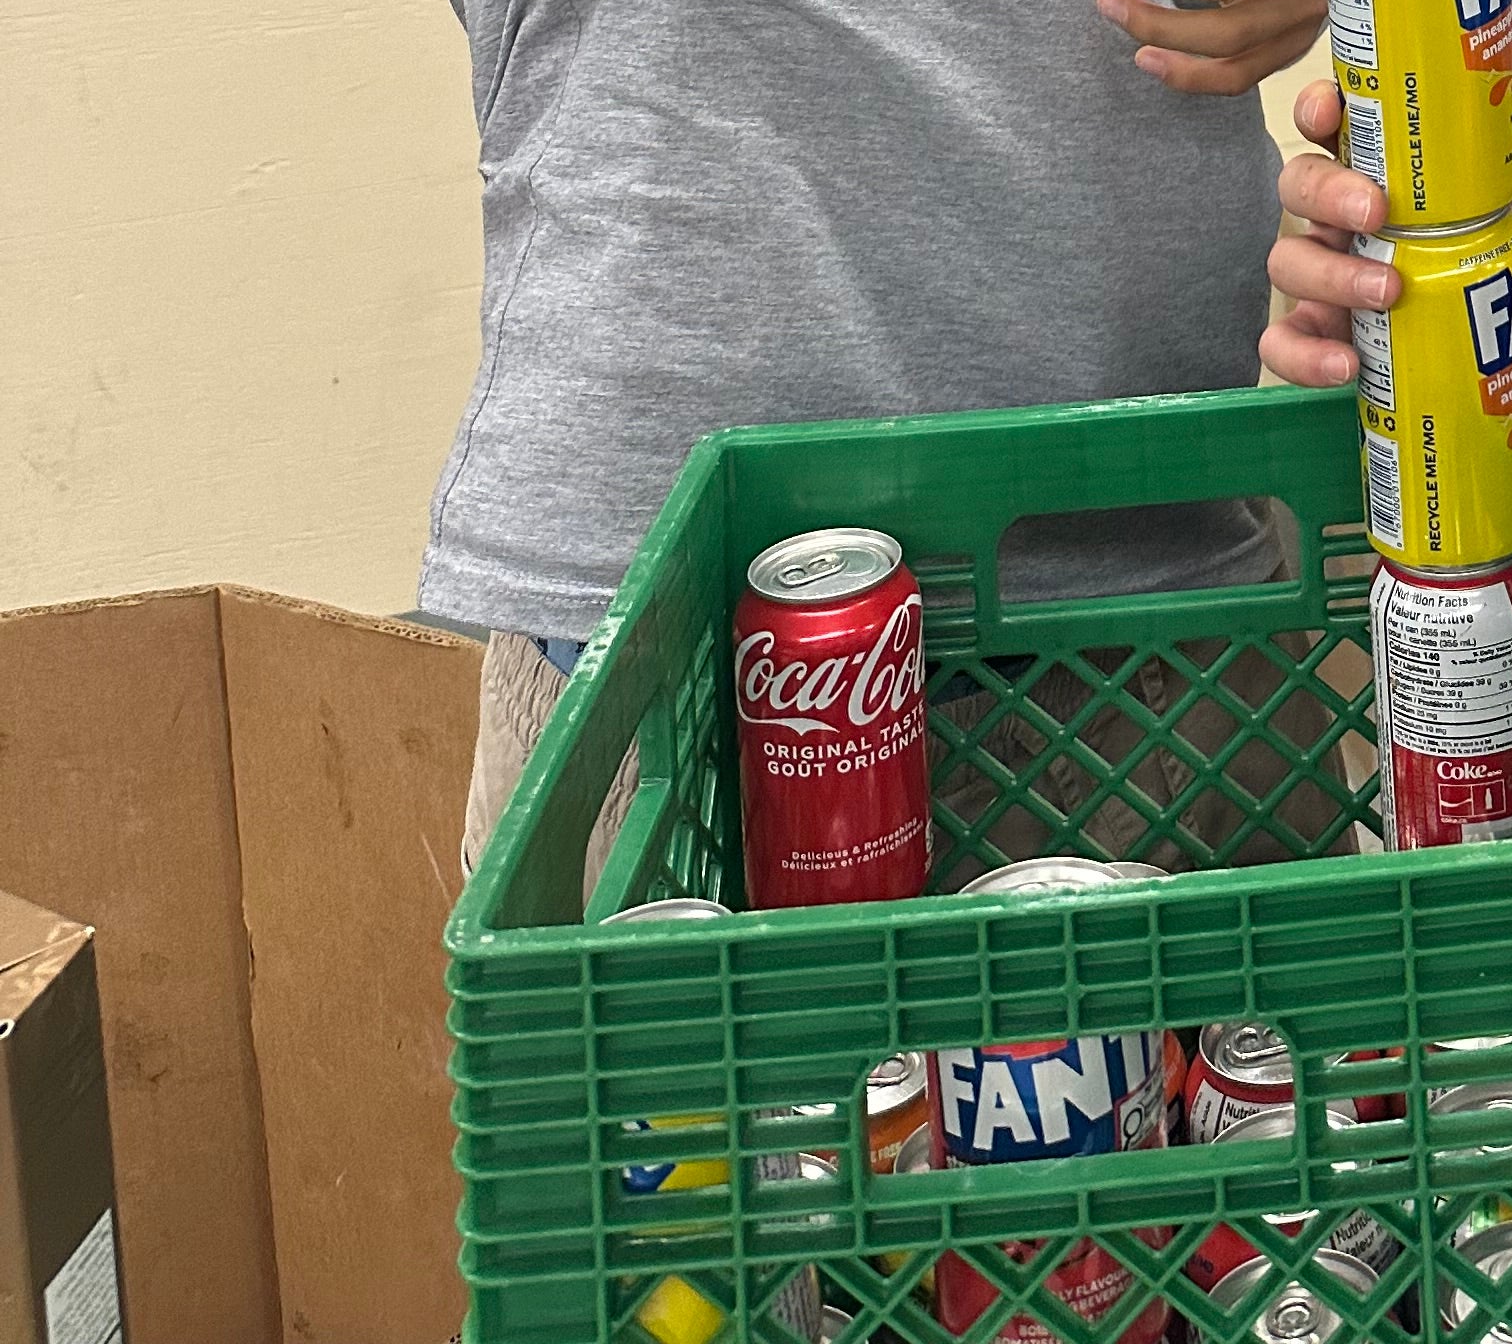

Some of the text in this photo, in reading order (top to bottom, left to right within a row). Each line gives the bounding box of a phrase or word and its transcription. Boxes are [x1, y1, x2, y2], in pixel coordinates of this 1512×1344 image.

[1404, 71, 1427, 212] RECYCLE ME/MOI
[1422, 413, 1441, 552] RECYCLE ME/MOI
[1390, 601, 1421, 623] Valeur
[1395, 586, 1469, 608] Nutrition Facts
[735, 593, 927, 736] Coca-Col
[1422, 651, 1440, 662] 140
[763, 701, 926, 761] ORIGINAL TASTE
[767, 725, 925, 778] GOÛT ORIGINAL
[1437, 760, 1487, 780] Coke
[791, 816, 919, 861] Delicious Refreshing
[781, 859, 837, 872] Délicieux
[841, 857, 854, 868] et
[937, 1032, 1148, 1151] FANT
